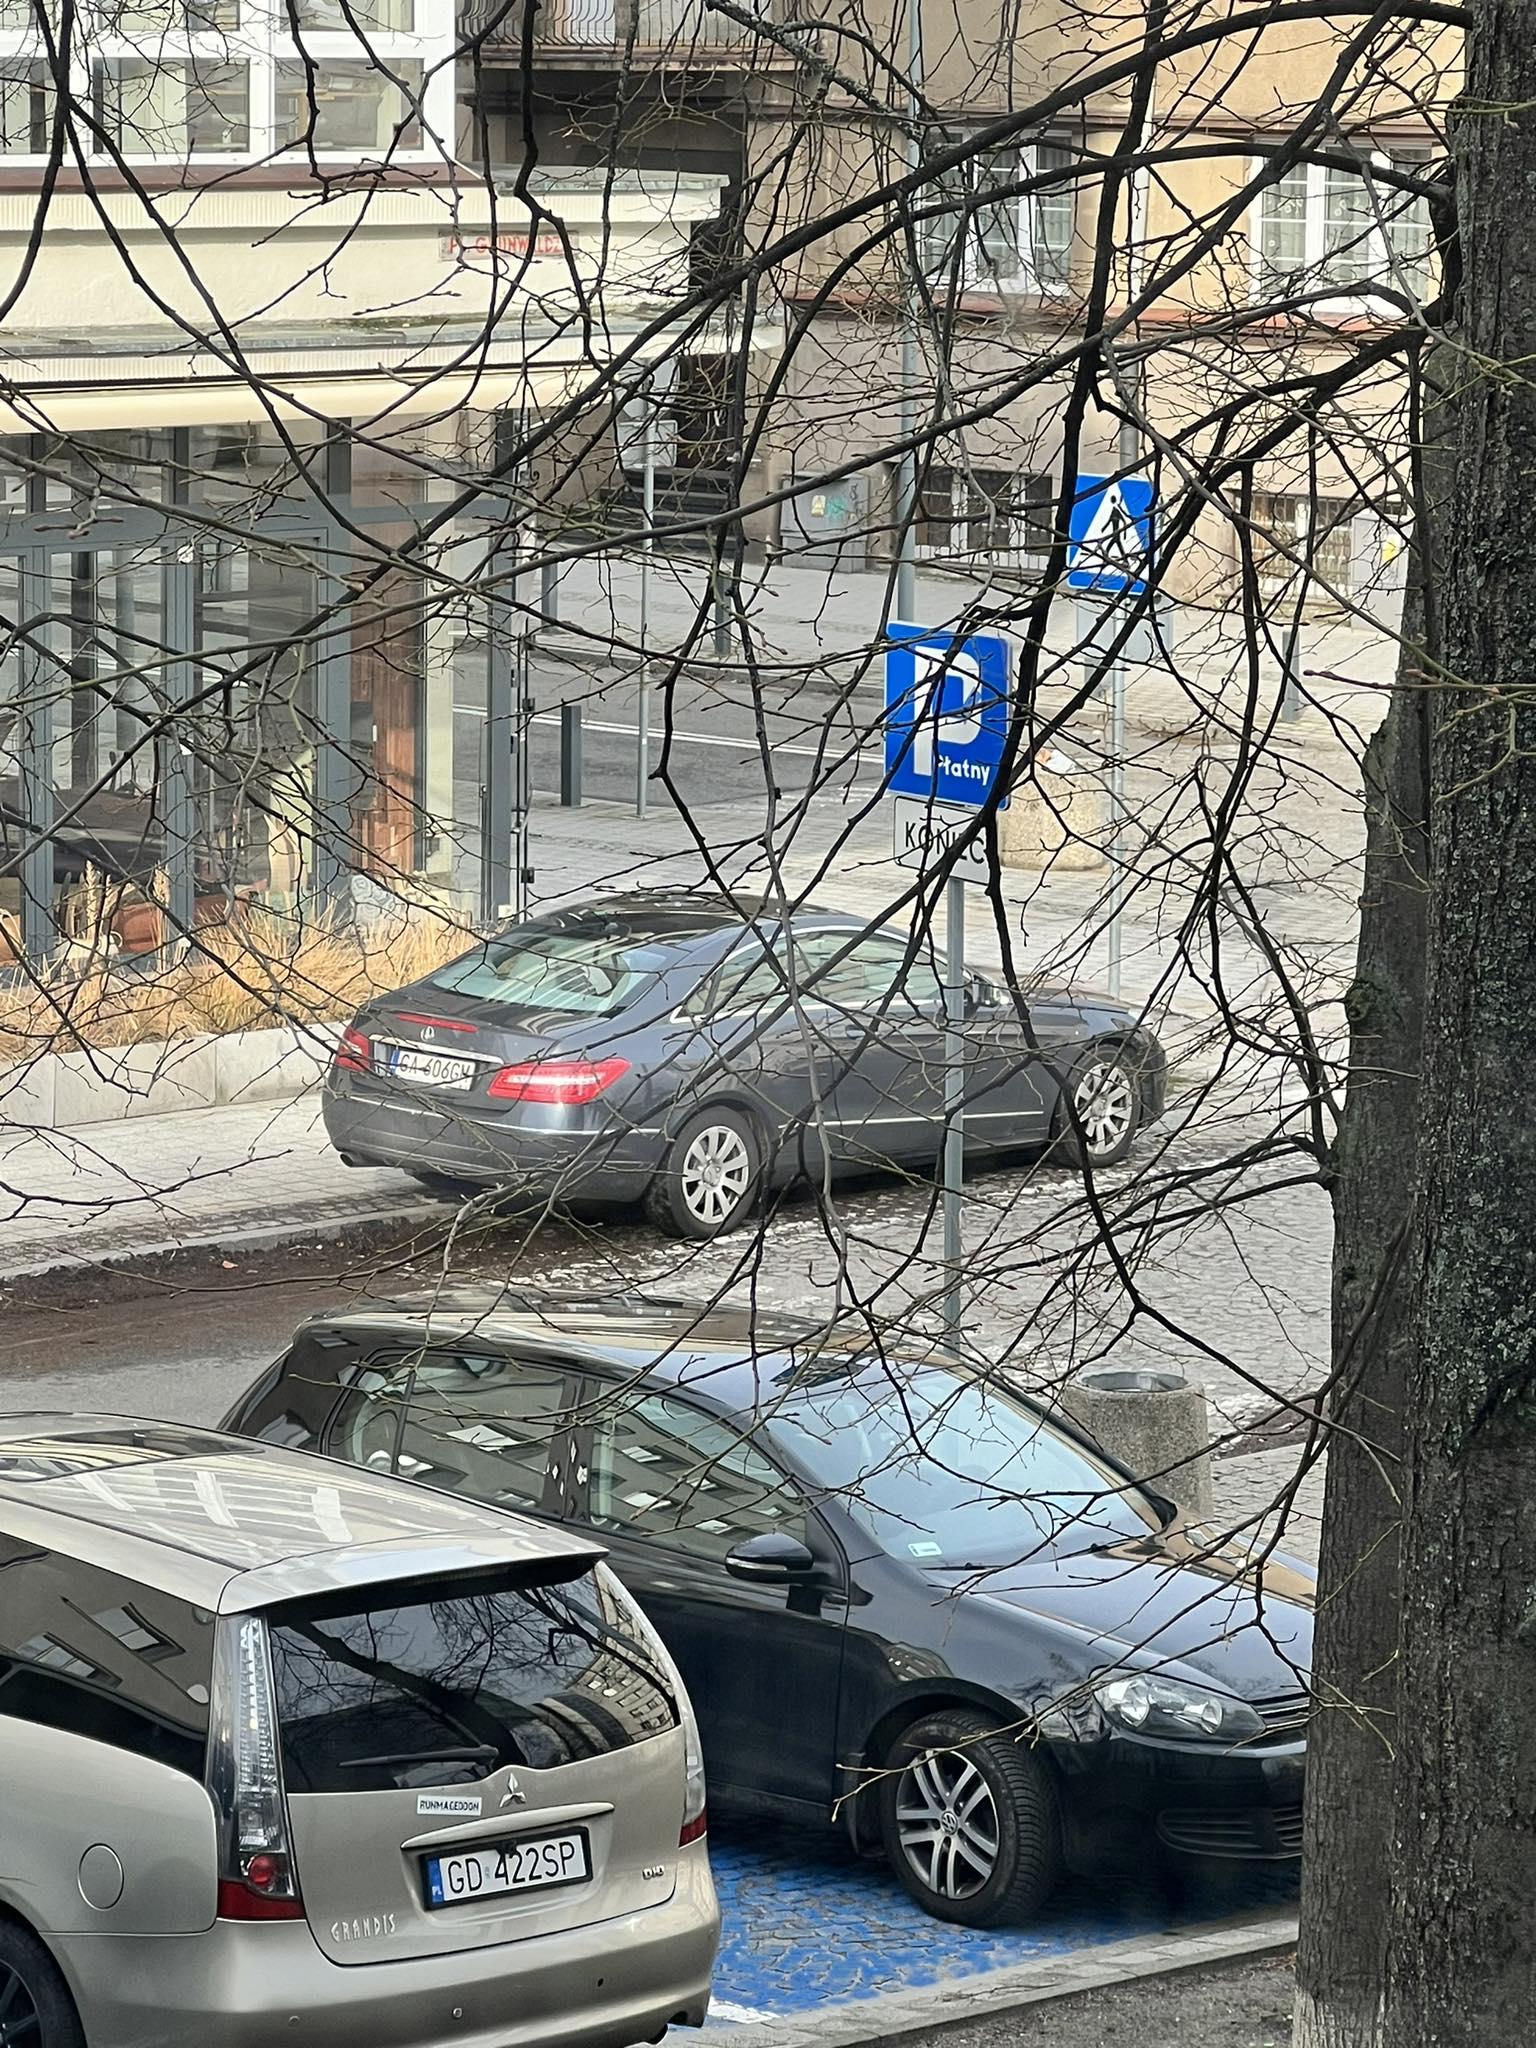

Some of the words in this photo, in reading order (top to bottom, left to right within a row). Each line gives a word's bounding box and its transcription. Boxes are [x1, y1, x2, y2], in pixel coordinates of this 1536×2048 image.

[905, 821, 984, 864] KONC
[400, 1054, 418, 1074] GA
[447, 1857, 482, 1893] GD
[494, 1841, 575, 1885] 422SP
[330, 1913, 396, 1942] GRANDIS
